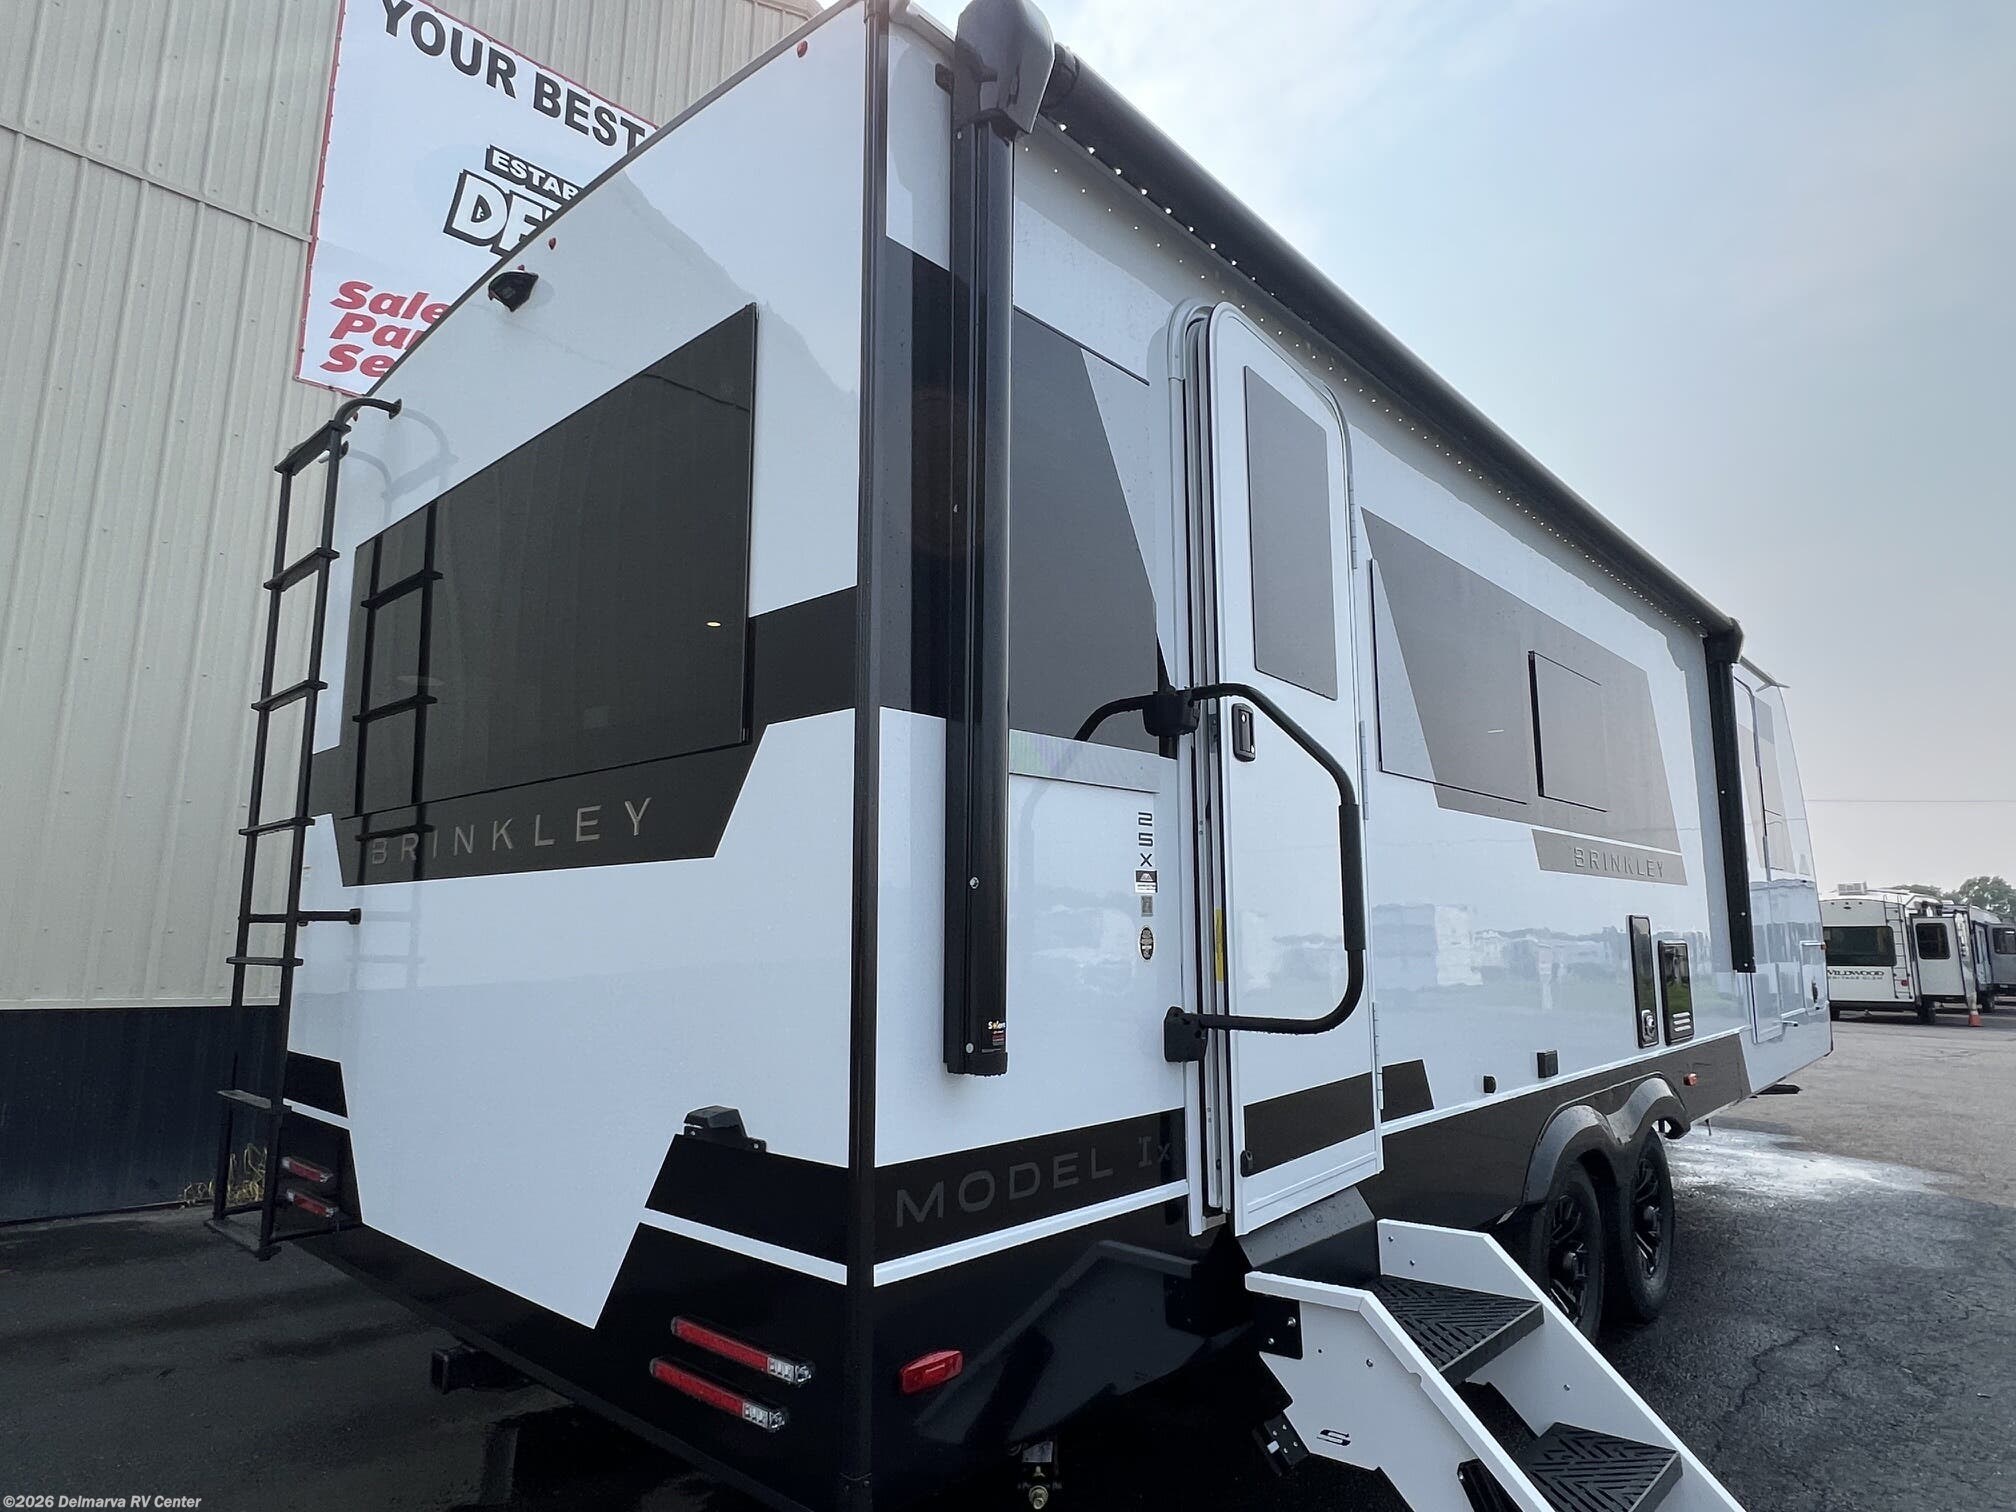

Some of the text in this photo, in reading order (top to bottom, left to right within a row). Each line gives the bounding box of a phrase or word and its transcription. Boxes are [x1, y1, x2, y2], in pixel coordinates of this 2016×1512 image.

[382, 0, 645, 155] YOUR BEST
[443, 169, 563, 258] DE
[330, 280, 451, 324] Sale
[370, 797, 652, 865] BRINKLEY
[1137, 811, 1154, 868] 25X
[1573, 847, 1664, 879] BRINKLEY
[896, 1144, 1114, 1228] MODEL
